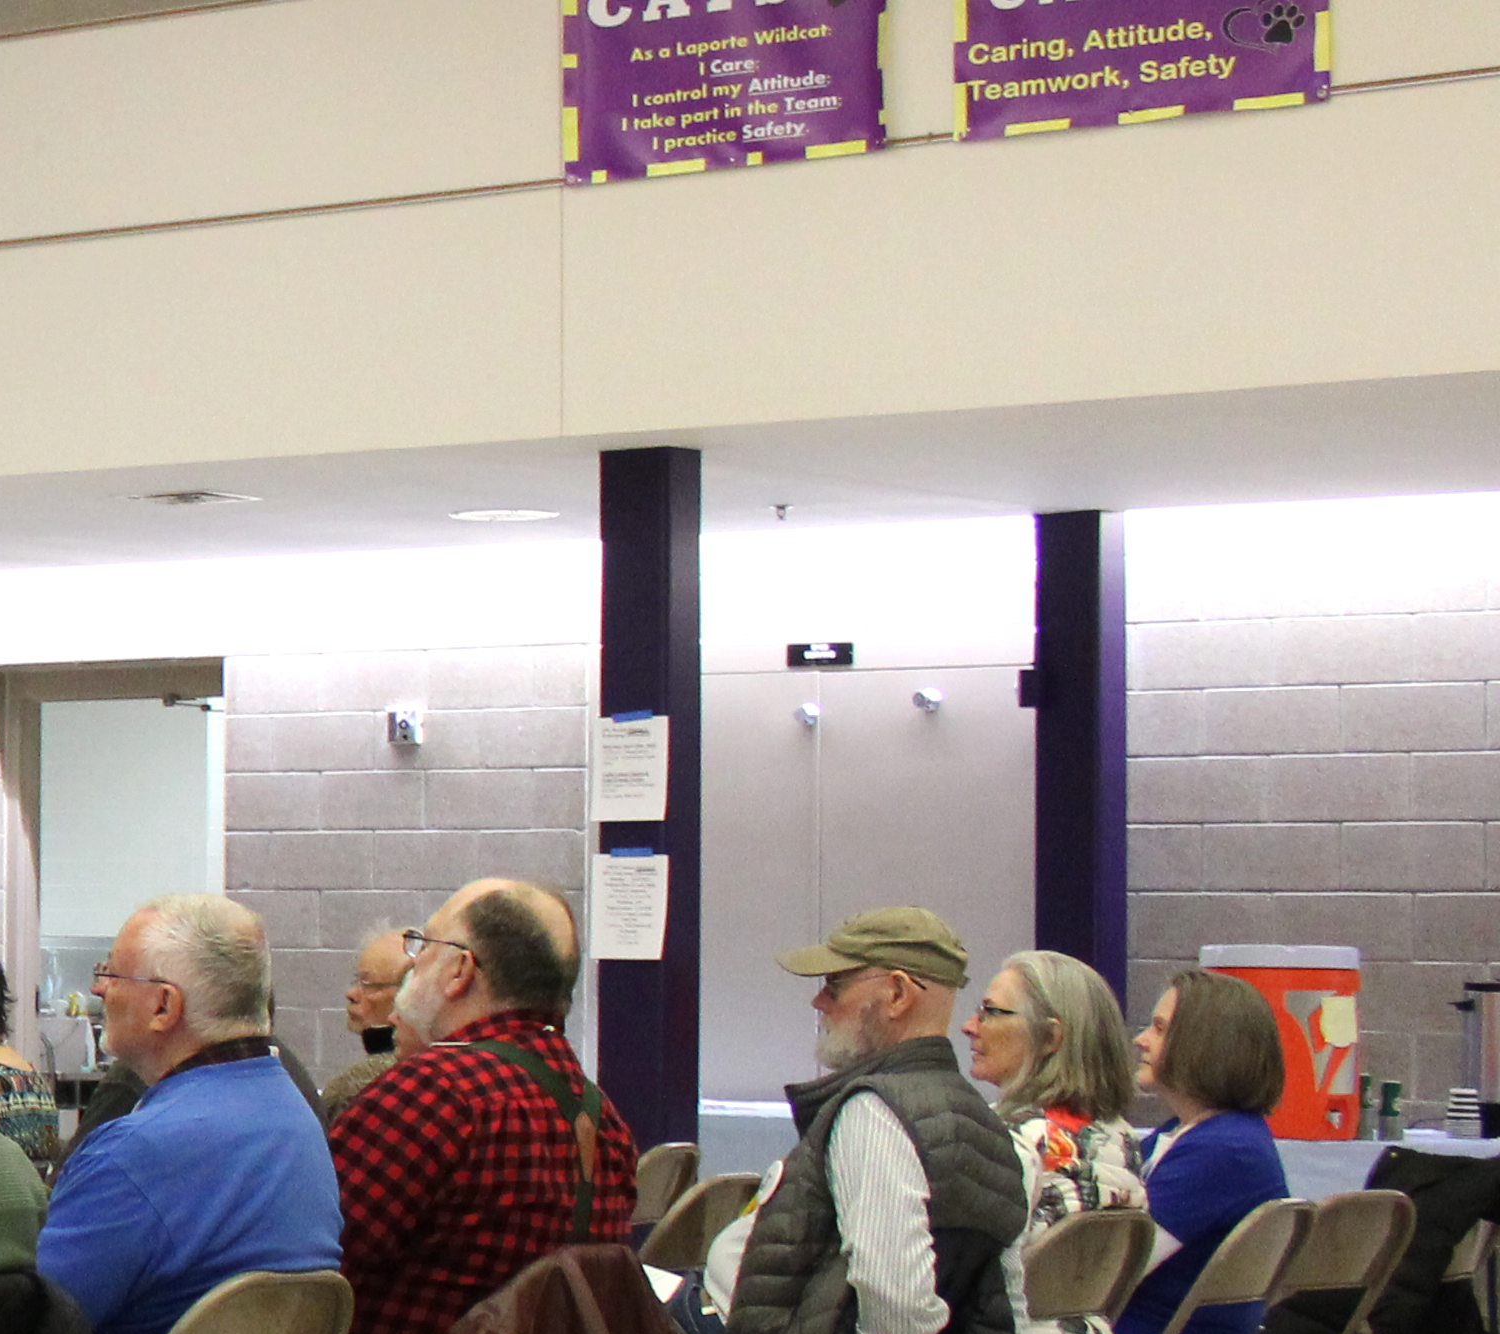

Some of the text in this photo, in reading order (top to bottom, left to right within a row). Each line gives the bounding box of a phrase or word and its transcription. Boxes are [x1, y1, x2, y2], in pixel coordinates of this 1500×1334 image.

[630, 47, 653, 62] As
[658, 47, 671, 59] a
[676, 36, 748, 56] Laporte
[967, 18, 1214, 66] Caring, Attitude,
[699, 62, 705, 75] I
[967, 53, 1237, 102] Teamwork, Safety
[632, 94, 638, 107] I
[643, 85, 707, 107] control
[712, 83, 742, 99] my
[621, 117, 627, 131] I
[633, 112, 676, 130] take
[680, 105, 719, 128] part
[724, 103, 742, 117] in
[748, 98, 779, 115] the
[652, 136, 658, 150] I
[664, 127, 738, 152] practice
